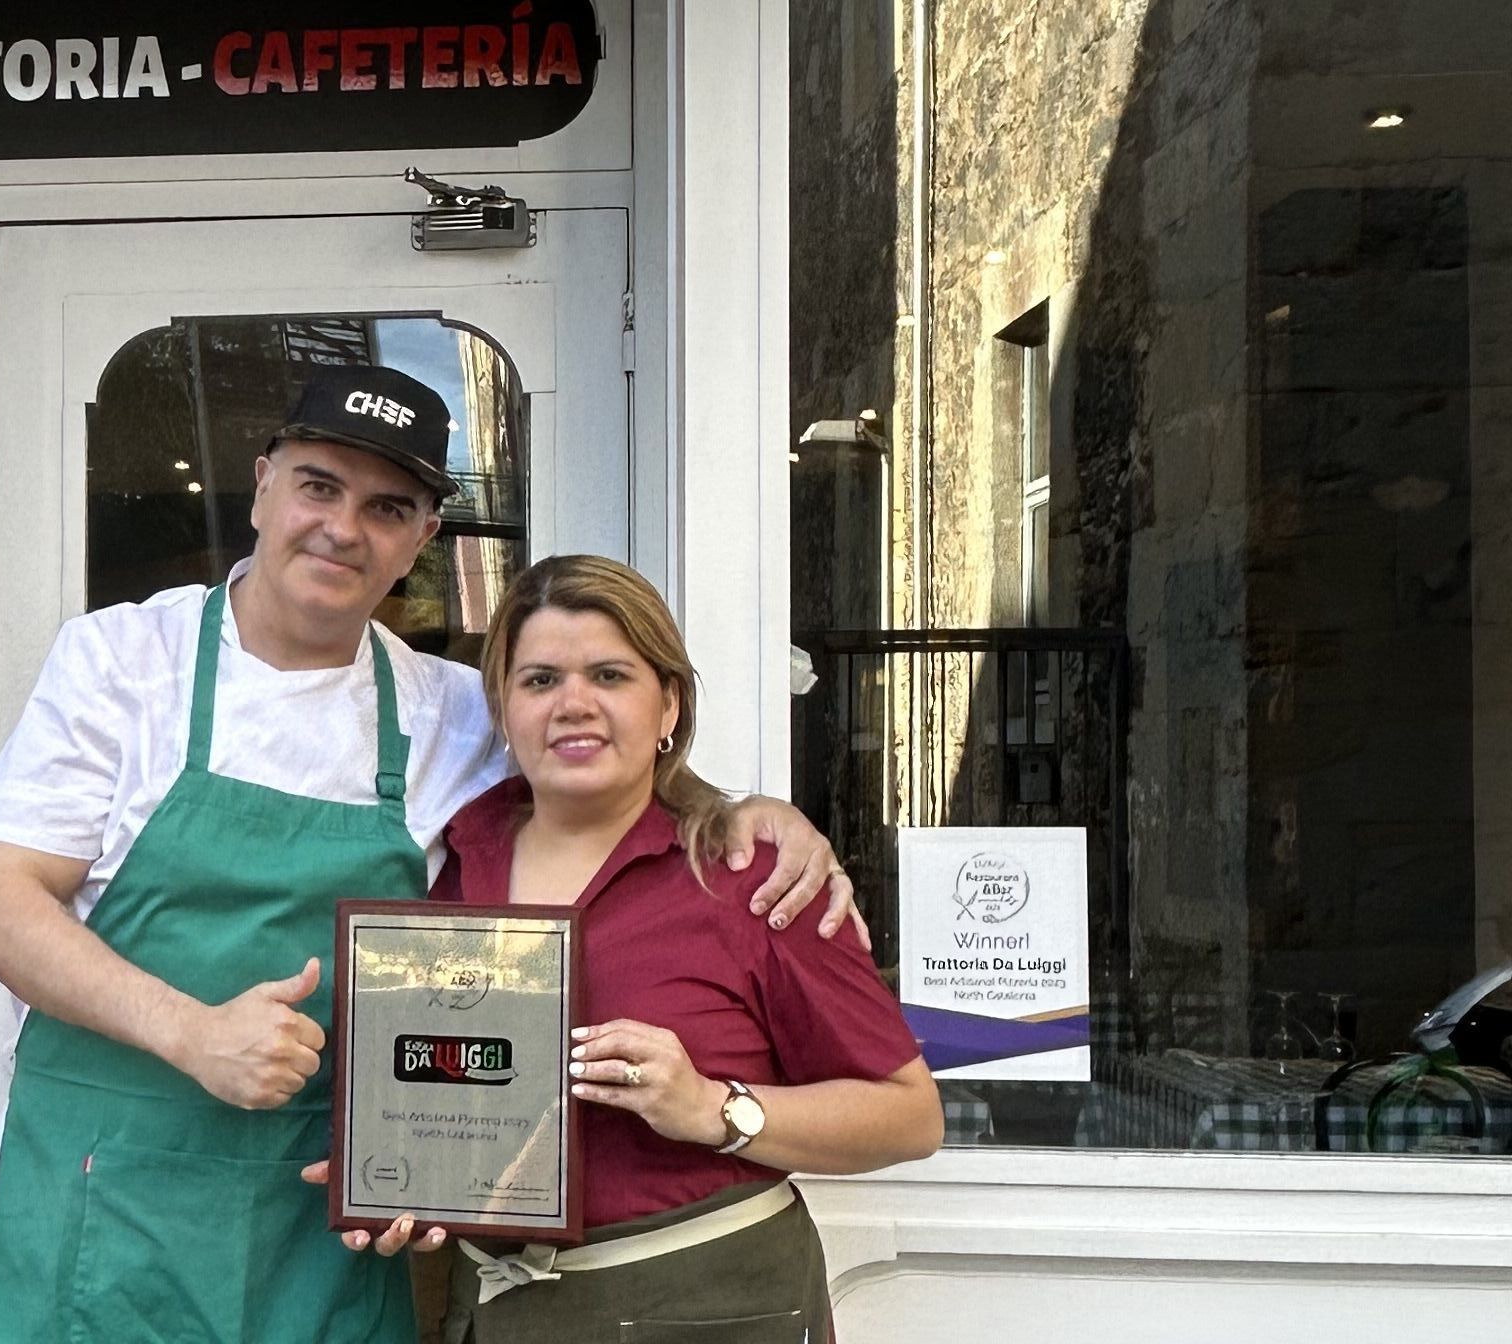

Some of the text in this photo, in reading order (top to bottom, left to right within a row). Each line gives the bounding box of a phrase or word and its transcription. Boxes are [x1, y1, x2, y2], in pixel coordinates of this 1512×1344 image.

[212, 0, 583, 96] CAFETERÍA
[344, 390, 417, 429] CHEF
[922, 957, 1067, 974] Trattoria Da Luiggi
[404, 1051, 433, 1072] DA
